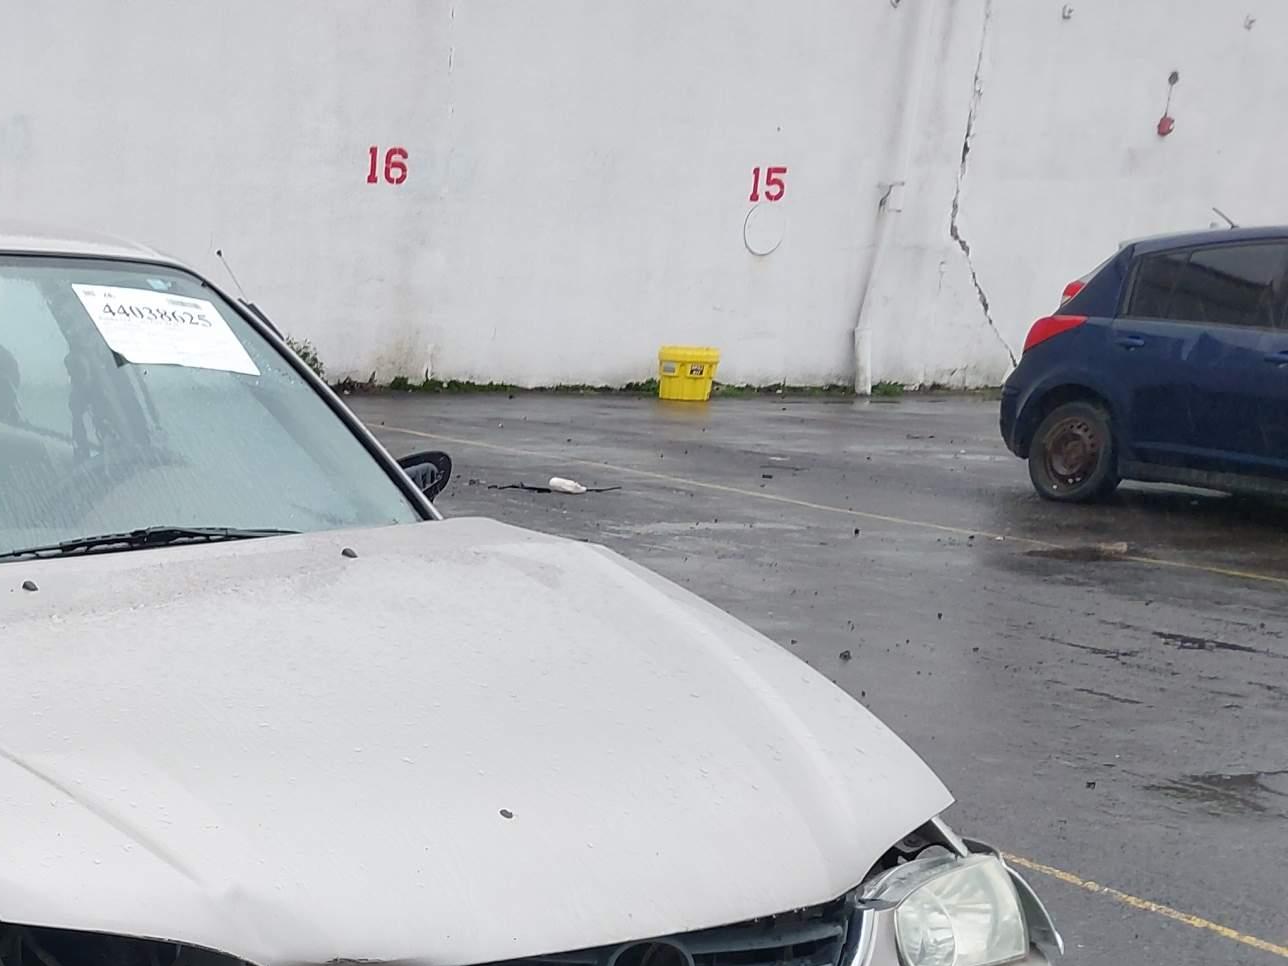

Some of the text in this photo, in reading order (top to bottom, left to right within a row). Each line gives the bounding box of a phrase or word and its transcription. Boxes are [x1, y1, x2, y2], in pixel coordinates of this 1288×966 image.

[366, 146, 408, 185] 16
[749, 166, 787, 203] 15
[102, 303, 213, 328] 44038625
